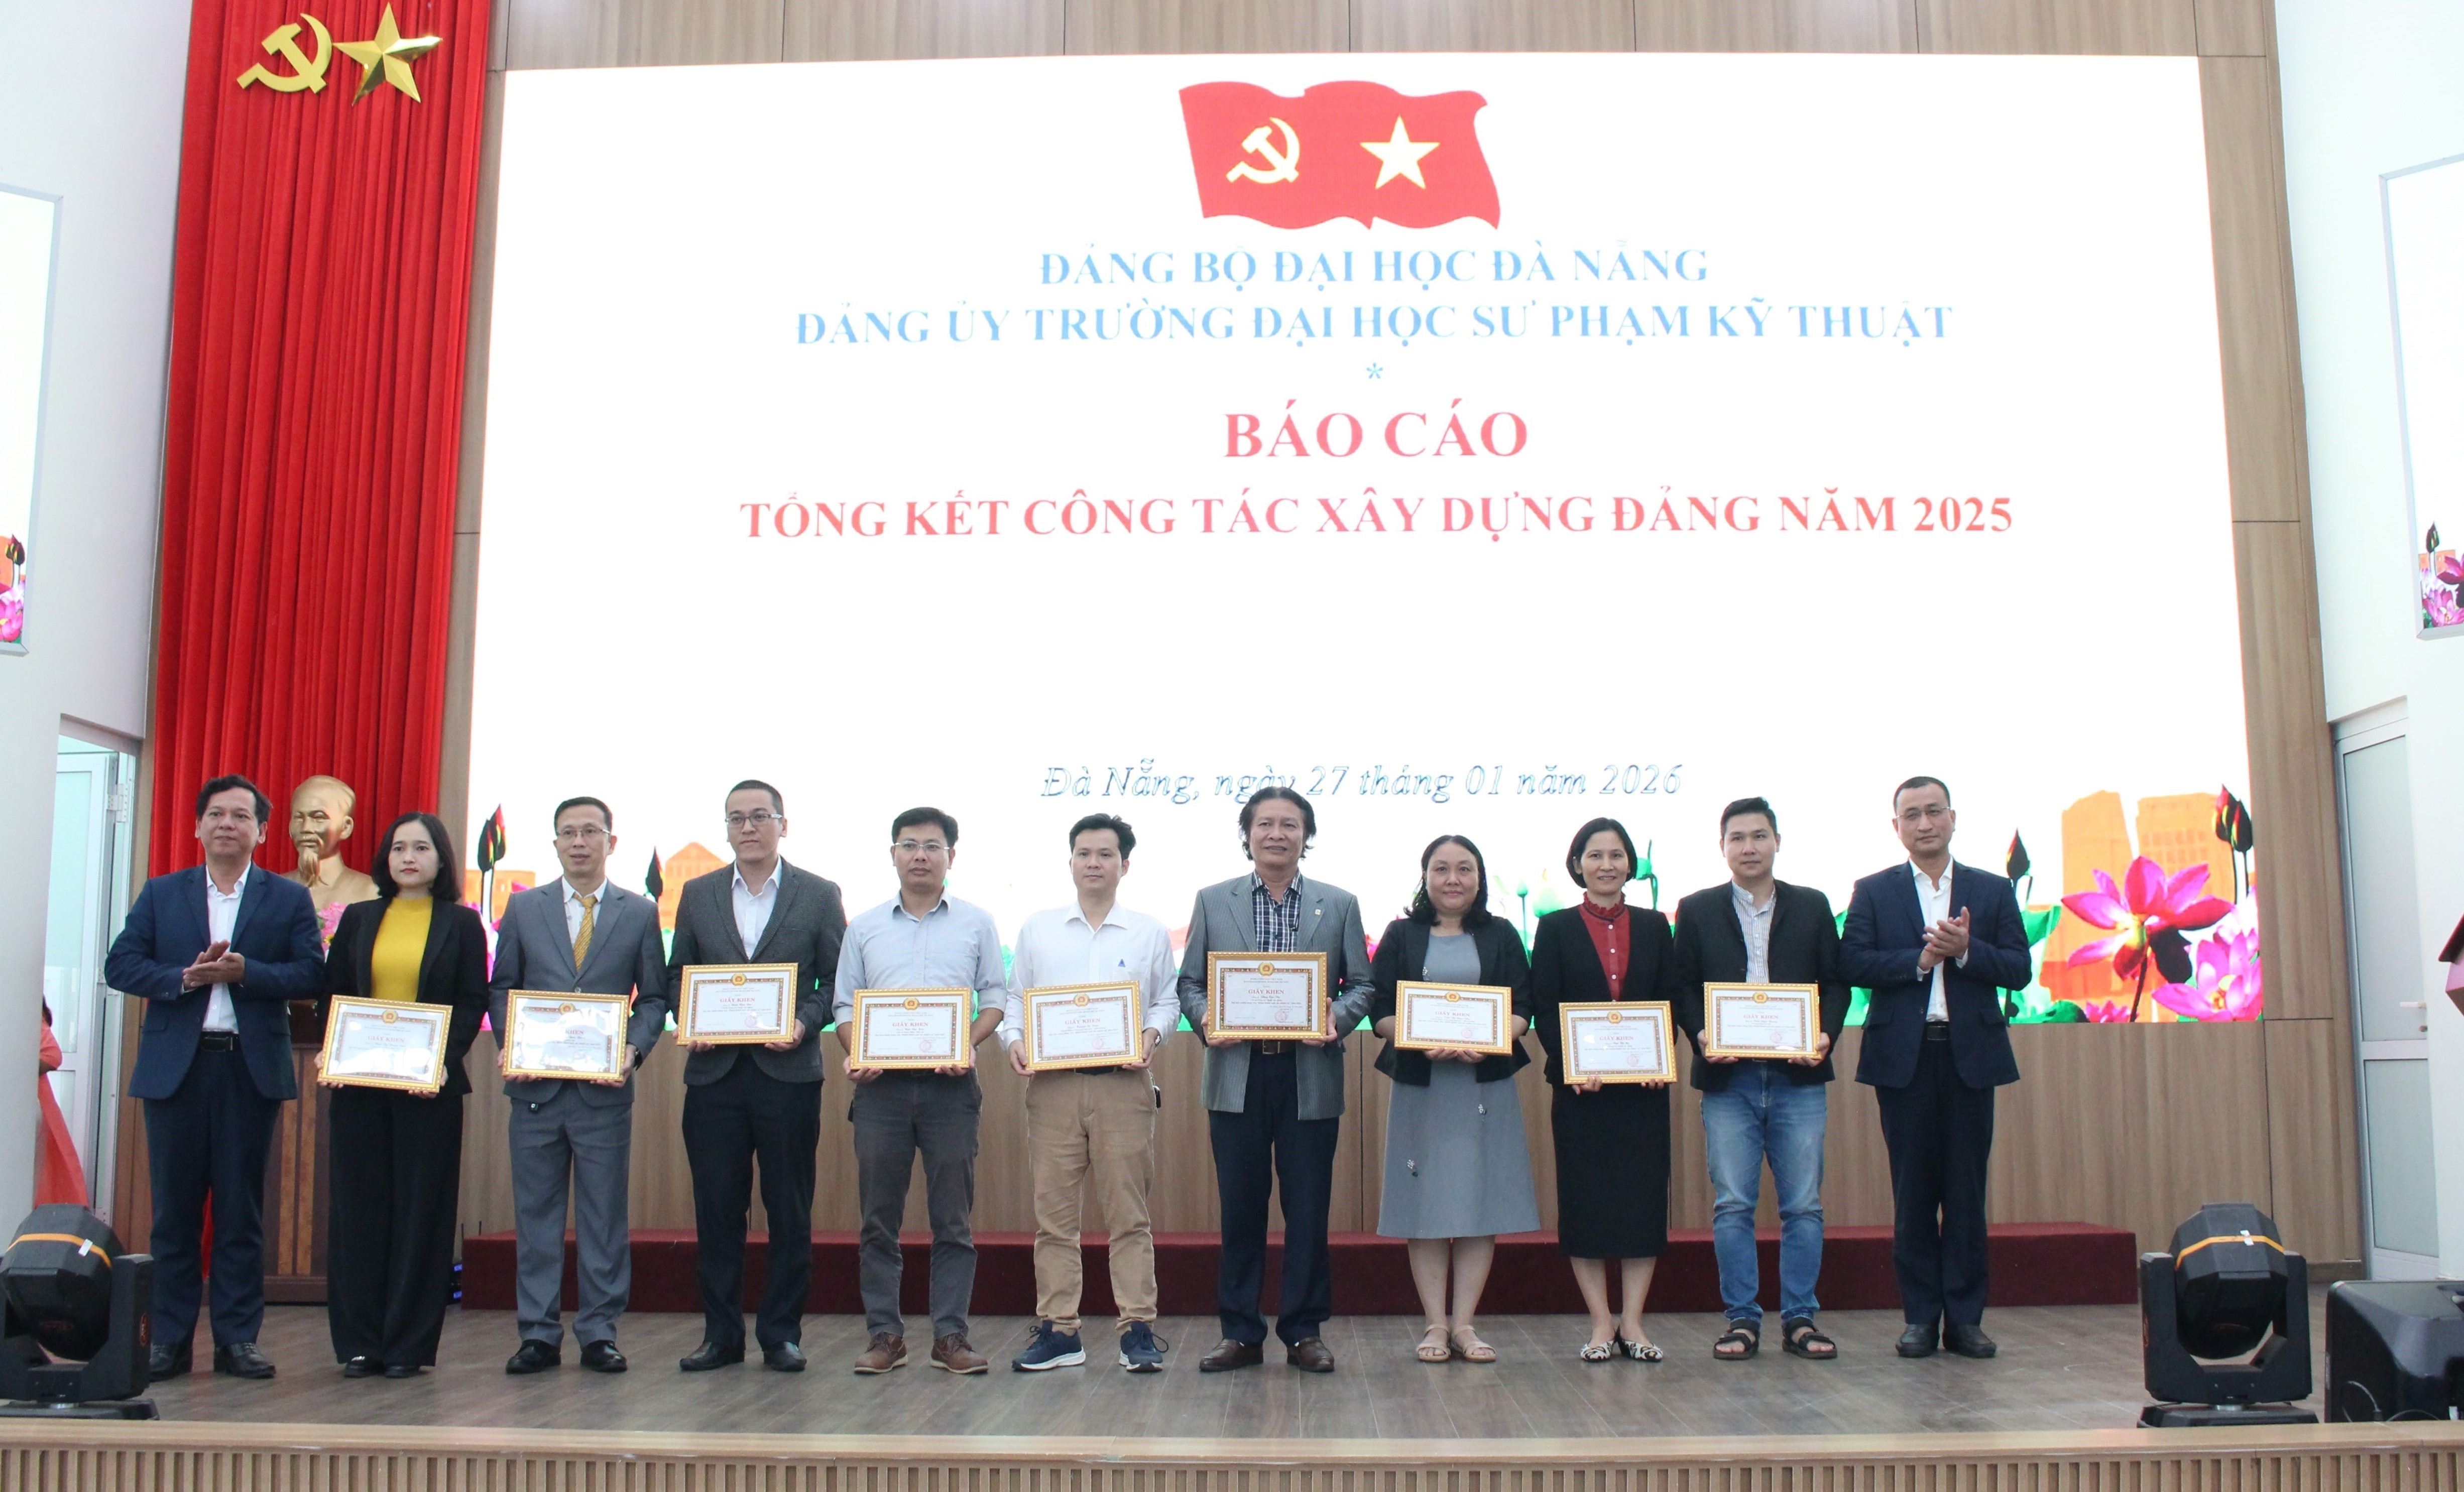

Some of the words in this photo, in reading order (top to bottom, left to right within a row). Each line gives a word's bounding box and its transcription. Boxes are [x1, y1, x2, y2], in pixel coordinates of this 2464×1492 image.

[1039, 242, 1174, 284] ĐẢNG
[1193, 246, 1257, 292] BỘ
[1273, 250, 1354, 292] ĐẠI
[1373, 250, 1476, 291] HỌC
[1492, 240, 1556, 281] ĐÀ
[1573, 240, 1707, 281] NẴNG
[795, 302, 929, 344] ĐẢNG
[949, 300, 1009, 342] ỦY
[1025, 297, 1233, 340] TRƯỜNG
[1253, 306, 1333, 346] ĐẠI
[1353, 305, 1455, 346] HỌC
[1473, 299, 1536, 337] SƯ
[1551, 305, 1690, 346] PHẠM
[1709, 296, 1773, 337] KỸ
[1788, 301, 1953, 346] THUẬT
[1223, 399, 1363, 457] BÁO
[1384, 398, 1528, 457] CÁO
[740, 492, 887, 538] TỔNG
[904, 489, 1009, 536] KẾT
[1023, 488, 1176, 535] CÔNG
[1192, 487, 1299, 533] TÁC
[1316, 486, 1425, 532] XÂY
[1442, 491, 1595, 543] DỰNG
[1611, 485, 1761, 532] ĐẢNG
[1778, 487, 1898, 531] NĂM
[1913, 496, 2012, 532] 2025
[1040, 766, 1091, 797] Đà
[1101, 758, 1200, 805] Nẵng,
[1307, 766, 1349, 795] 27
[1359, 765, 1454, 803] tháng
[1466, 765, 1502, 795] 01
[1517, 765, 1586, 795] năm
[1599, 764, 1683, 794] 2026
